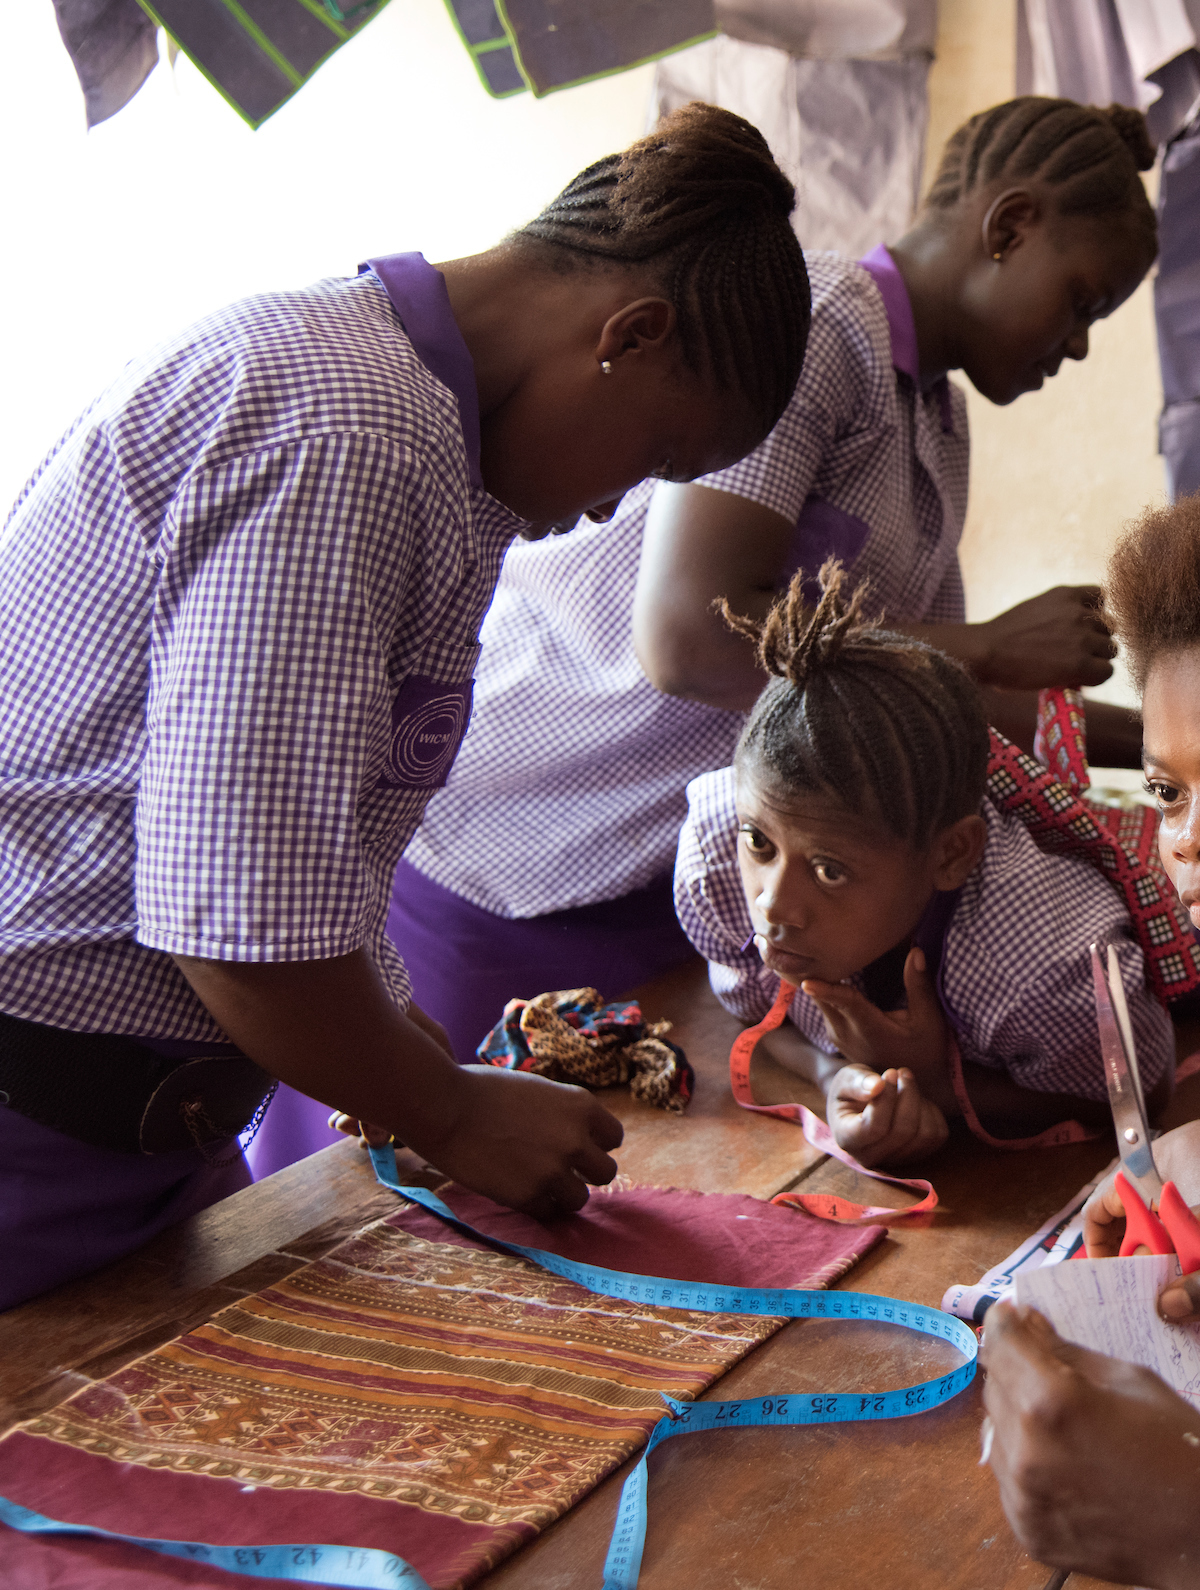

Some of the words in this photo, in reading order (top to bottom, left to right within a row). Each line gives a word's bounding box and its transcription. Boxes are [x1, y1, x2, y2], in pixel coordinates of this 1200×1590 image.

[828, 1204, 838, 1217] 4
[587, 1276, 596, 1287] 25
[601, 1278, 610, 1290] 26
[615, 1282, 623, 1293] 27
[630, 1285, 638, 1296] 28
[644, 1287, 654, 1299] 29
[662, 1289, 672, 1301] 30
[680, 1292, 689, 1303] 31
[696, 1294, 706, 1306] 32
[715, 1296, 725, 1308] 33
[732, 1298, 742, 1309] 34
[750, 1299, 760, 1310] 35
[768, 1300, 777, 1310] 36
[784, 1302, 793, 1312] 37
[801, 1302, 810, 1313] 38
[817, 1302, 826, 1313] 39
[834, 1302, 842, 1314] 40
[851, 1304, 860, 1314] 41
[868, 1306, 877, 1316] 42
[884, 1308, 893, 1318] 43
[900, 1312, 908, 1322] 44
[916, 1316, 924, 1327] 45
[930, 1320, 939, 1331] 46
[944, 1325, 952, 1336] 47
[954, 1332, 962, 1342] 48
[940, 1375, 955, 1396] 22
[860, 1397, 886, 1412] 24
[905, 1388, 926, 1406] 23
[716, 1404, 742, 1420] 27
[762, 1399, 789, 1416] 26
[811, 1398, 838, 1414] 25
[625, 1502, 636, 1512] 81
[623, 1514, 635, 1524] 82
[621, 1526, 634, 1535] 83
[233, 1548, 267, 1566] 43
[291, 1547, 323, 1567] 42
[614, 1556, 627, 1564] 86
[612, 1569, 624, 1577] 87
